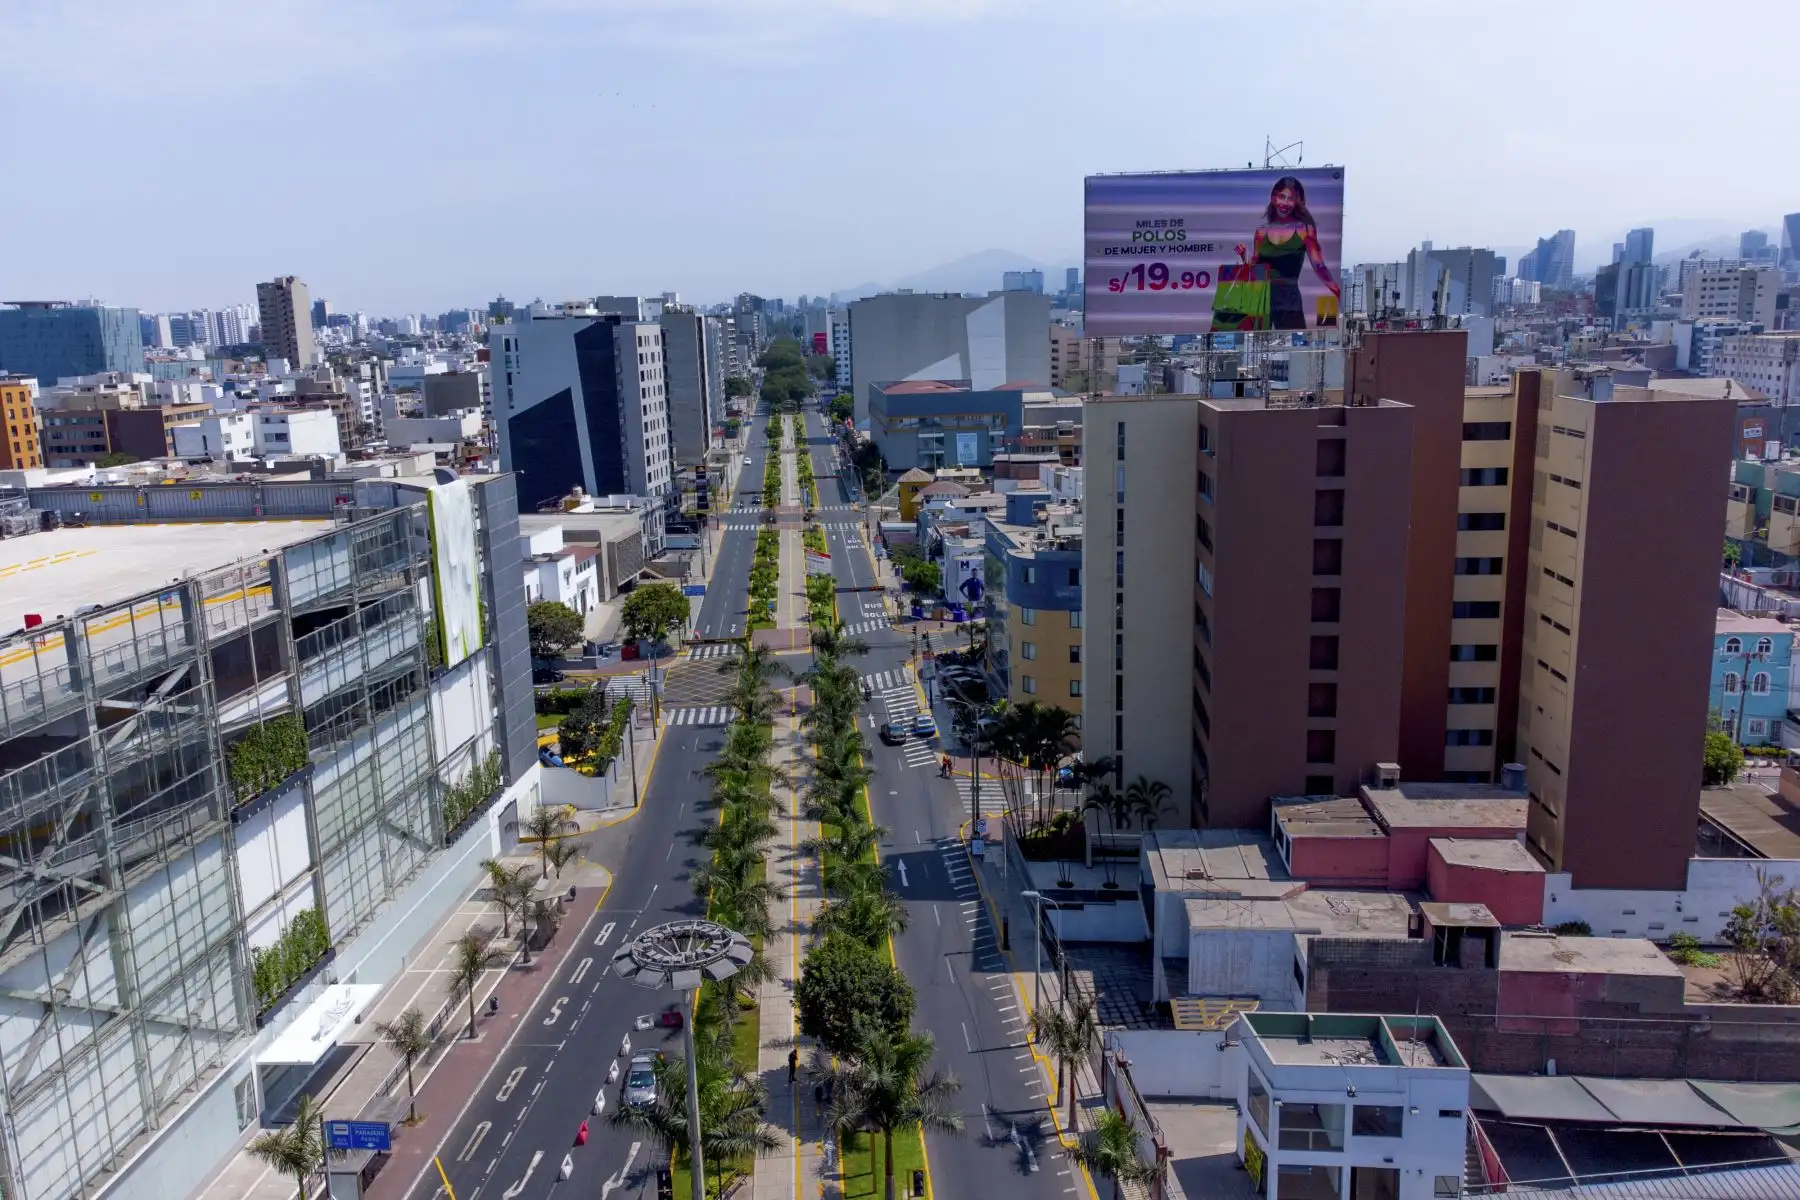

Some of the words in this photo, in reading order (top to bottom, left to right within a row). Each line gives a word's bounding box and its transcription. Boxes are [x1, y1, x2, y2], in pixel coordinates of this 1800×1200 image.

[1136, 219, 1168, 229] MILES
[1170, 218, 1184, 228] DE
[1132, 229, 1187, 242] POLOS
[1104, 247, 1119, 256] DE
[1120, 245, 1157, 255] MUJER
[1159, 245, 1166, 254] Y
[1168, 243, 1214, 253] HOMBRE
